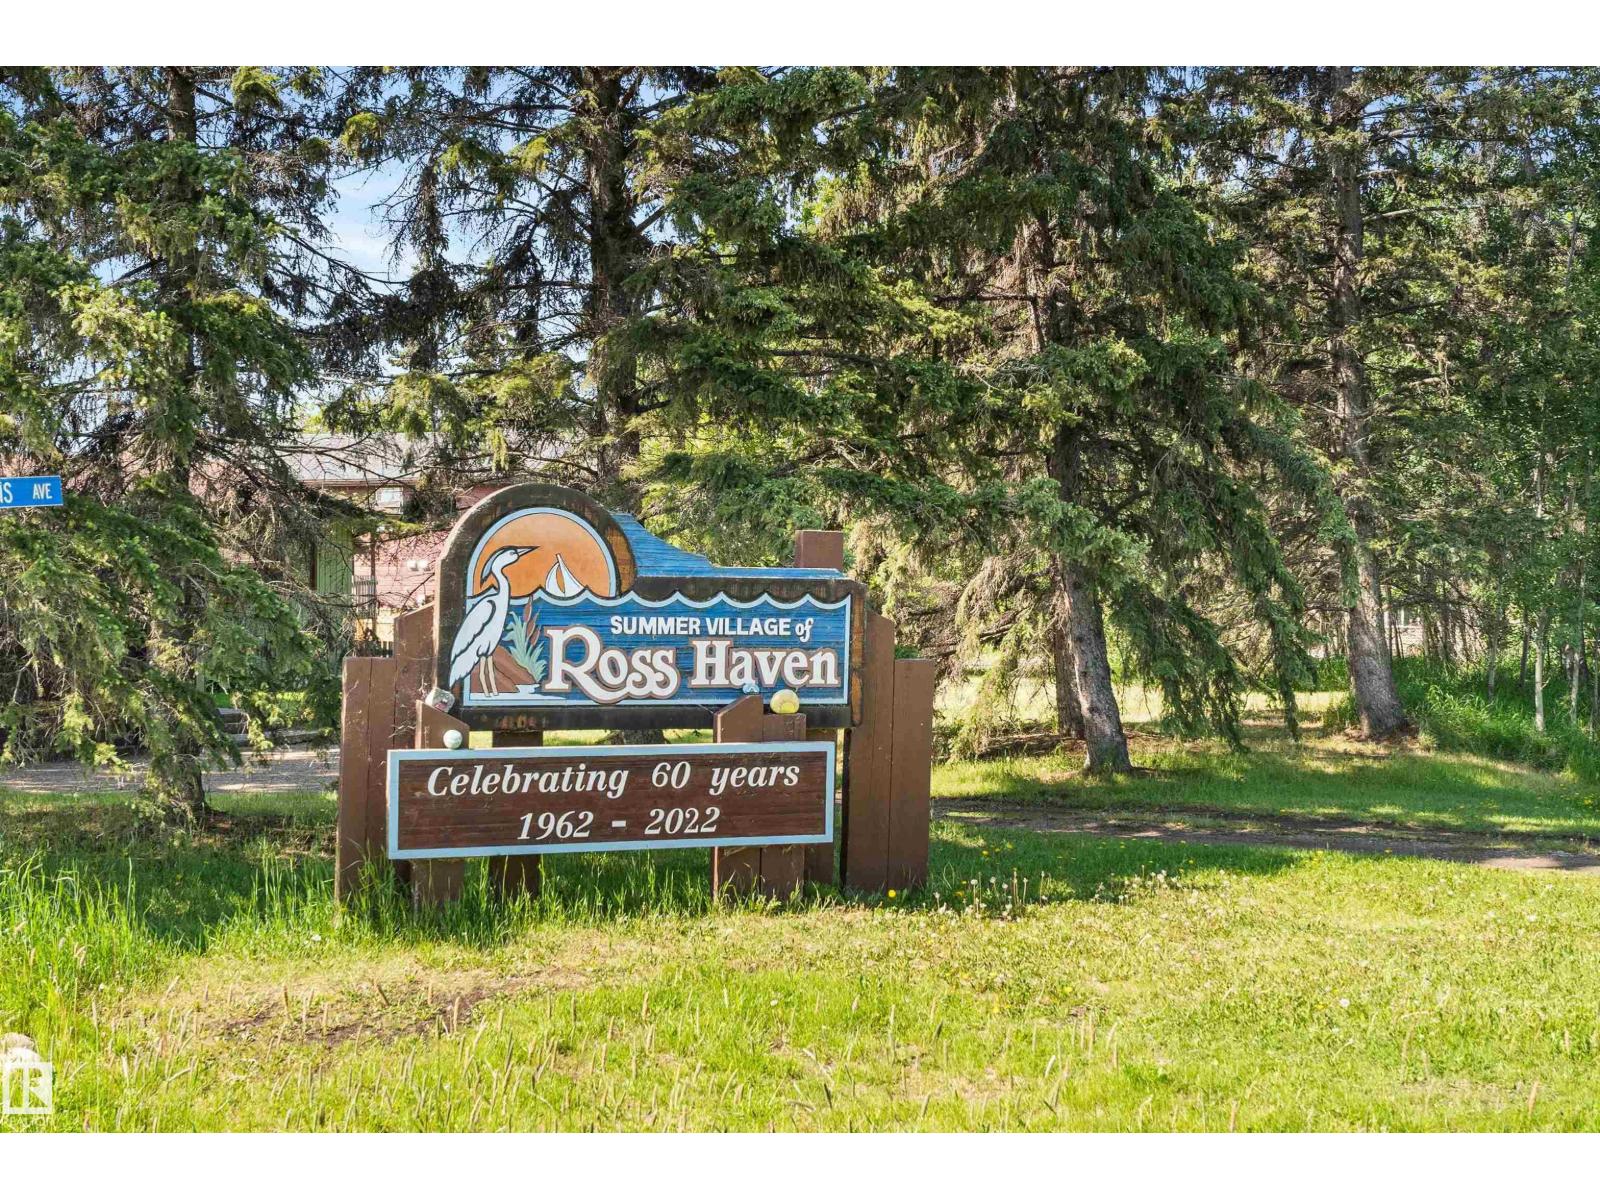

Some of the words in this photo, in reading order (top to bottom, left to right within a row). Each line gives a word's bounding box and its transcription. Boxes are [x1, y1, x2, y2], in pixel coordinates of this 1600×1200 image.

[32, 483, 53, 500] AVE
[610, 615, 700, 635] SUMMER
[705, 617, 791, 636] VILLAGE
[795, 617, 814, 643] of
[544, 626, 679, 701] Ross
[691, 640, 839, 687] Haven
[427, 763, 629, 798] Celebrating
[651, 761, 691, 789] 60
[709, 764, 801, 796] years
[517, 811, 594, 840] 1962
[643, 807, 721, 835] 2022
